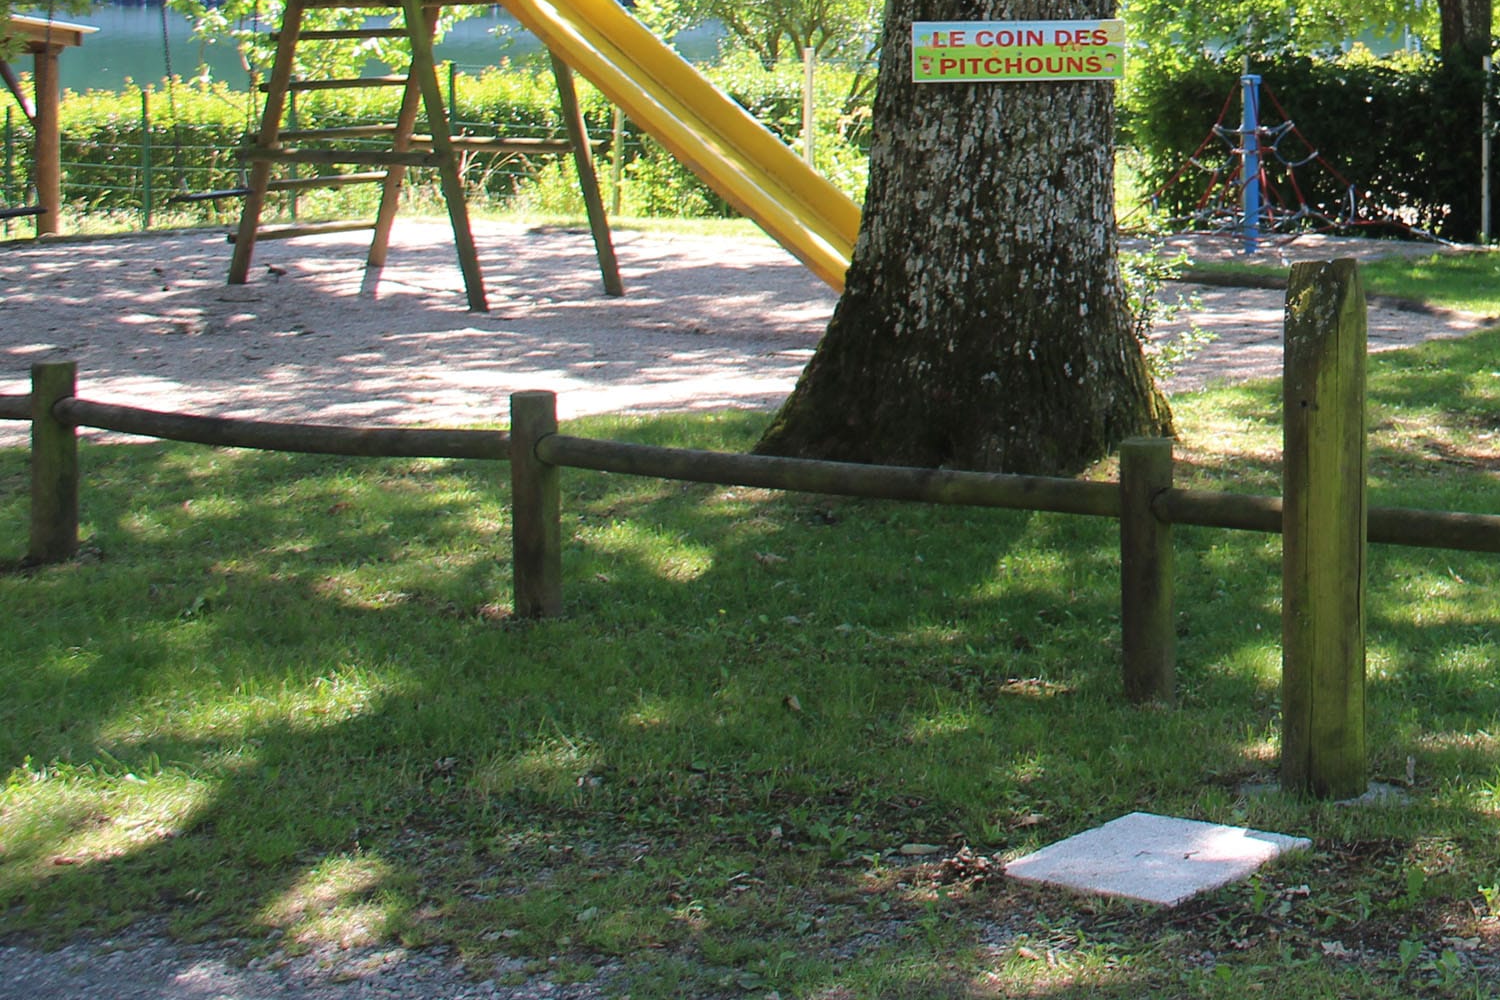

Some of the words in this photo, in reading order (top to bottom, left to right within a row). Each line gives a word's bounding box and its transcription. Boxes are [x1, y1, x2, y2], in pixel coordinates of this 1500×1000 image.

[932, 31, 966, 48] LE
[975, 30, 1043, 47] COIN
[1054, 29, 1108, 47] DES
[939, 56, 1102, 75] PITCHOUNS
